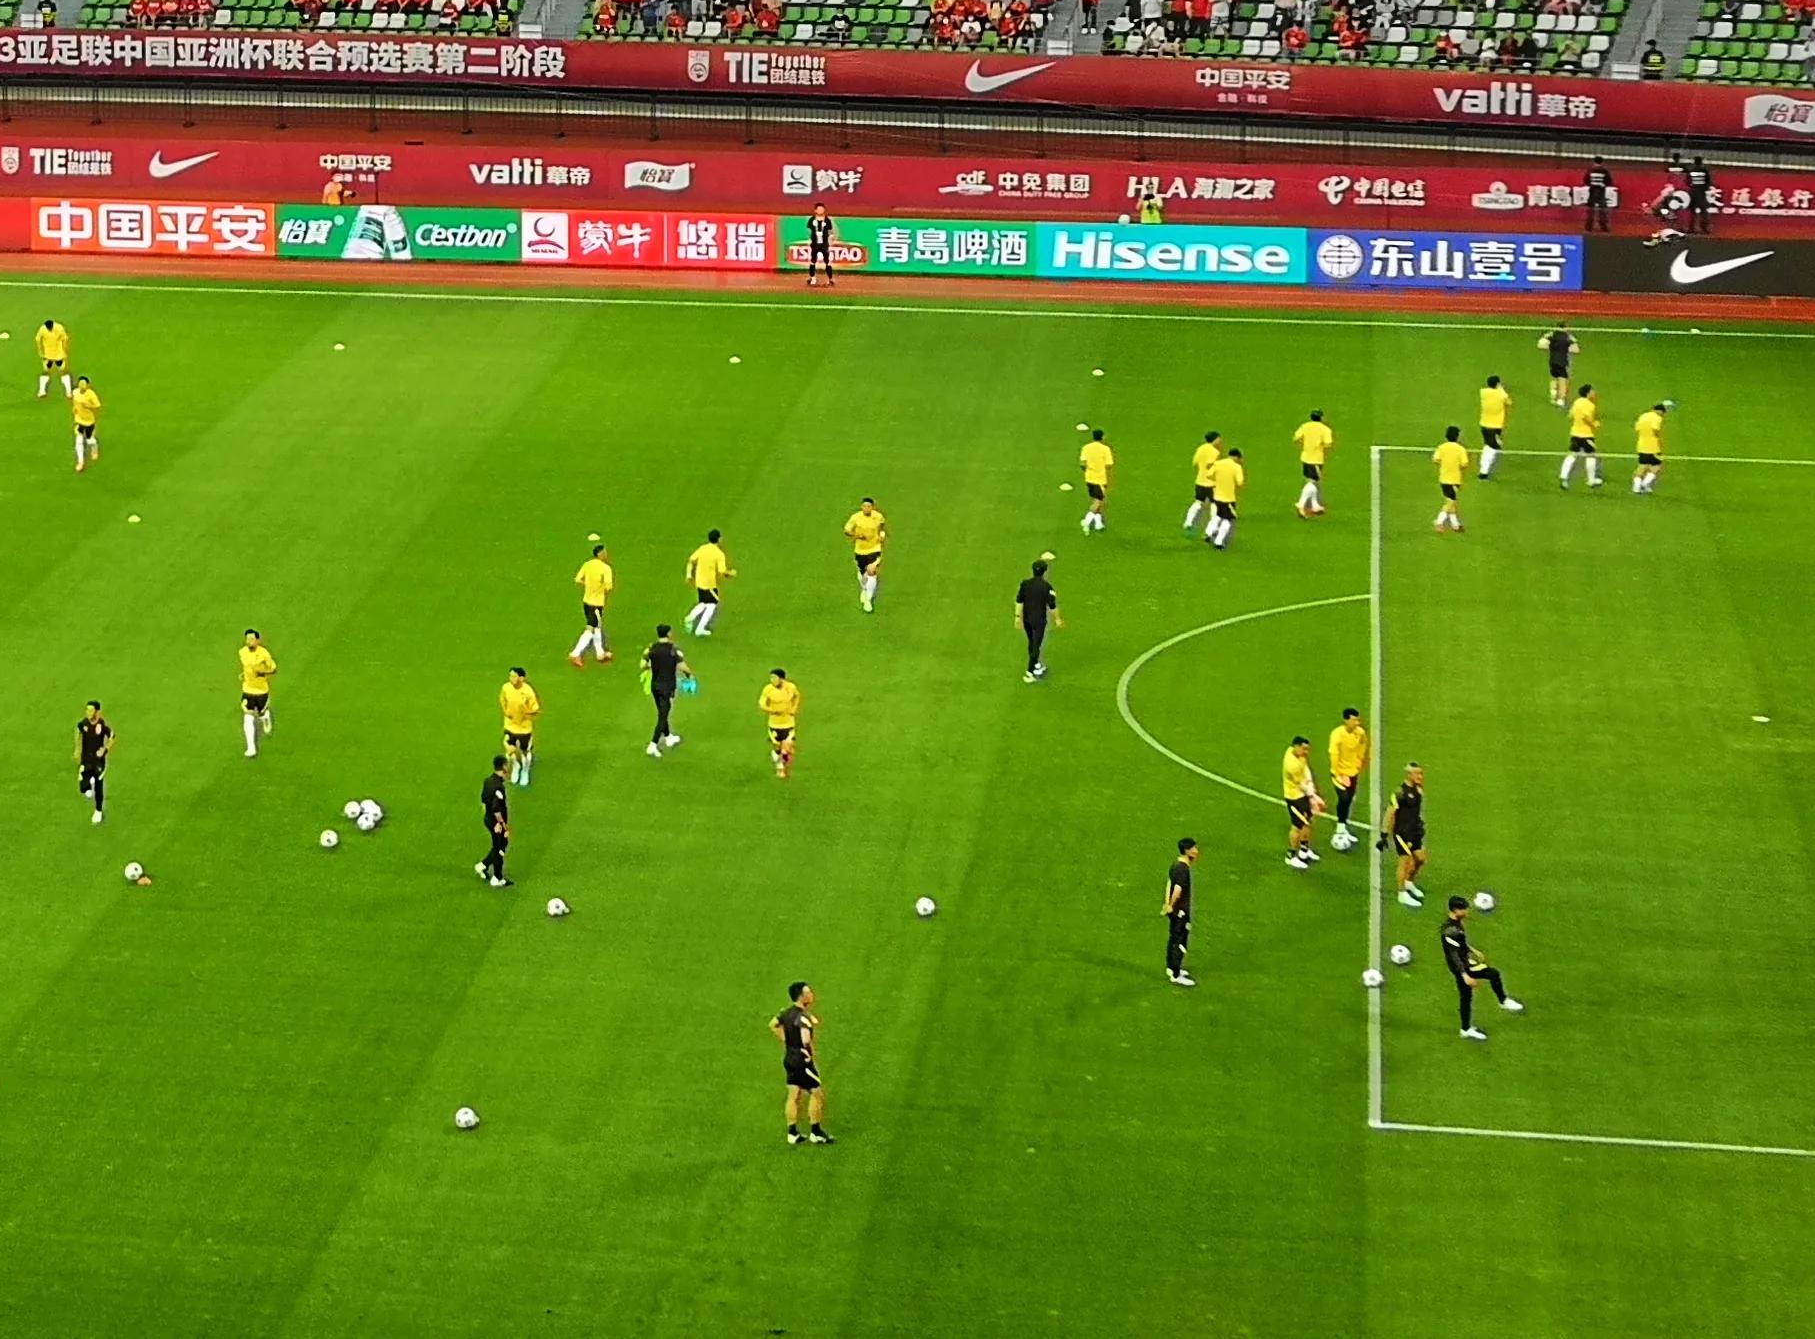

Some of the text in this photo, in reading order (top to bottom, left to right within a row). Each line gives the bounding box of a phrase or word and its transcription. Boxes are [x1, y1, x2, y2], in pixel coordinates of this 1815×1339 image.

[724, 52, 826, 84] TIE Together
[770, 69, 826, 85] 团结是铁
[1195, 68, 1291, 90] 中国平安
[1433, 81, 1533, 117] vatti
[1537, 93, 1597, 119] 華帝
[30, 148, 66, 175] TIE
[319, 154, 392, 172] 中国平安
[469, 158, 543, 186] vatti
[956, 170, 986, 184] cdf
[998, 171, 1090, 192] 中免集团
[38, 200, 267, 252] 中国平安
[279, 218, 333, 245] 怡寶
[577, 219, 767, 261] 蒙牛 悠瑞
[875, 225, 1028, 267] 青岛啤酒
[1052, 230, 1289, 274] Hisense
[1370, 236, 1568, 282] 东山壹号
